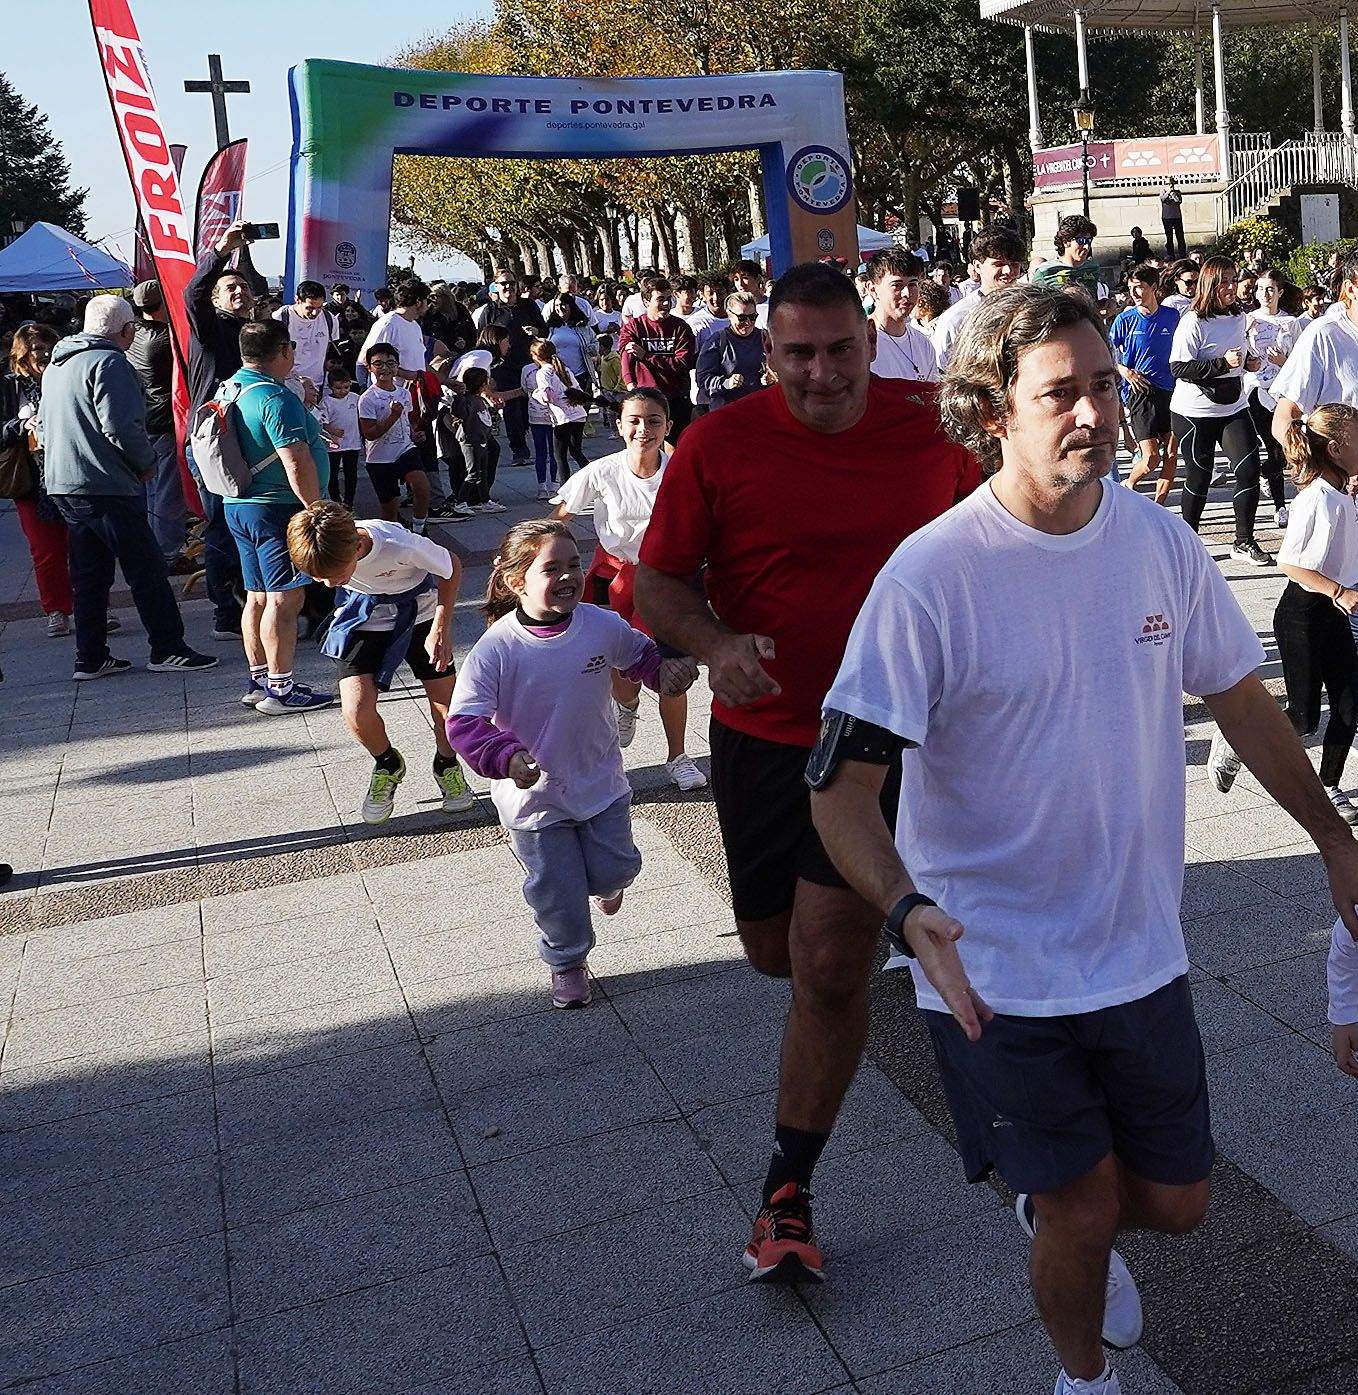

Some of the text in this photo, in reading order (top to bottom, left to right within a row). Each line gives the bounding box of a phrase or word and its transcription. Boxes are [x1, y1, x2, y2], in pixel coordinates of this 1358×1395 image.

[394, 91, 777, 115] DEPORTE PONTEVEDRA
[546, 121, 646, 131] deportes.pontevedra.gal
[99, 43, 190, 256] FROIZ
[797, 154, 840, 170] DEPORTE
[796, 181, 846, 207] PONTEVEDRA
